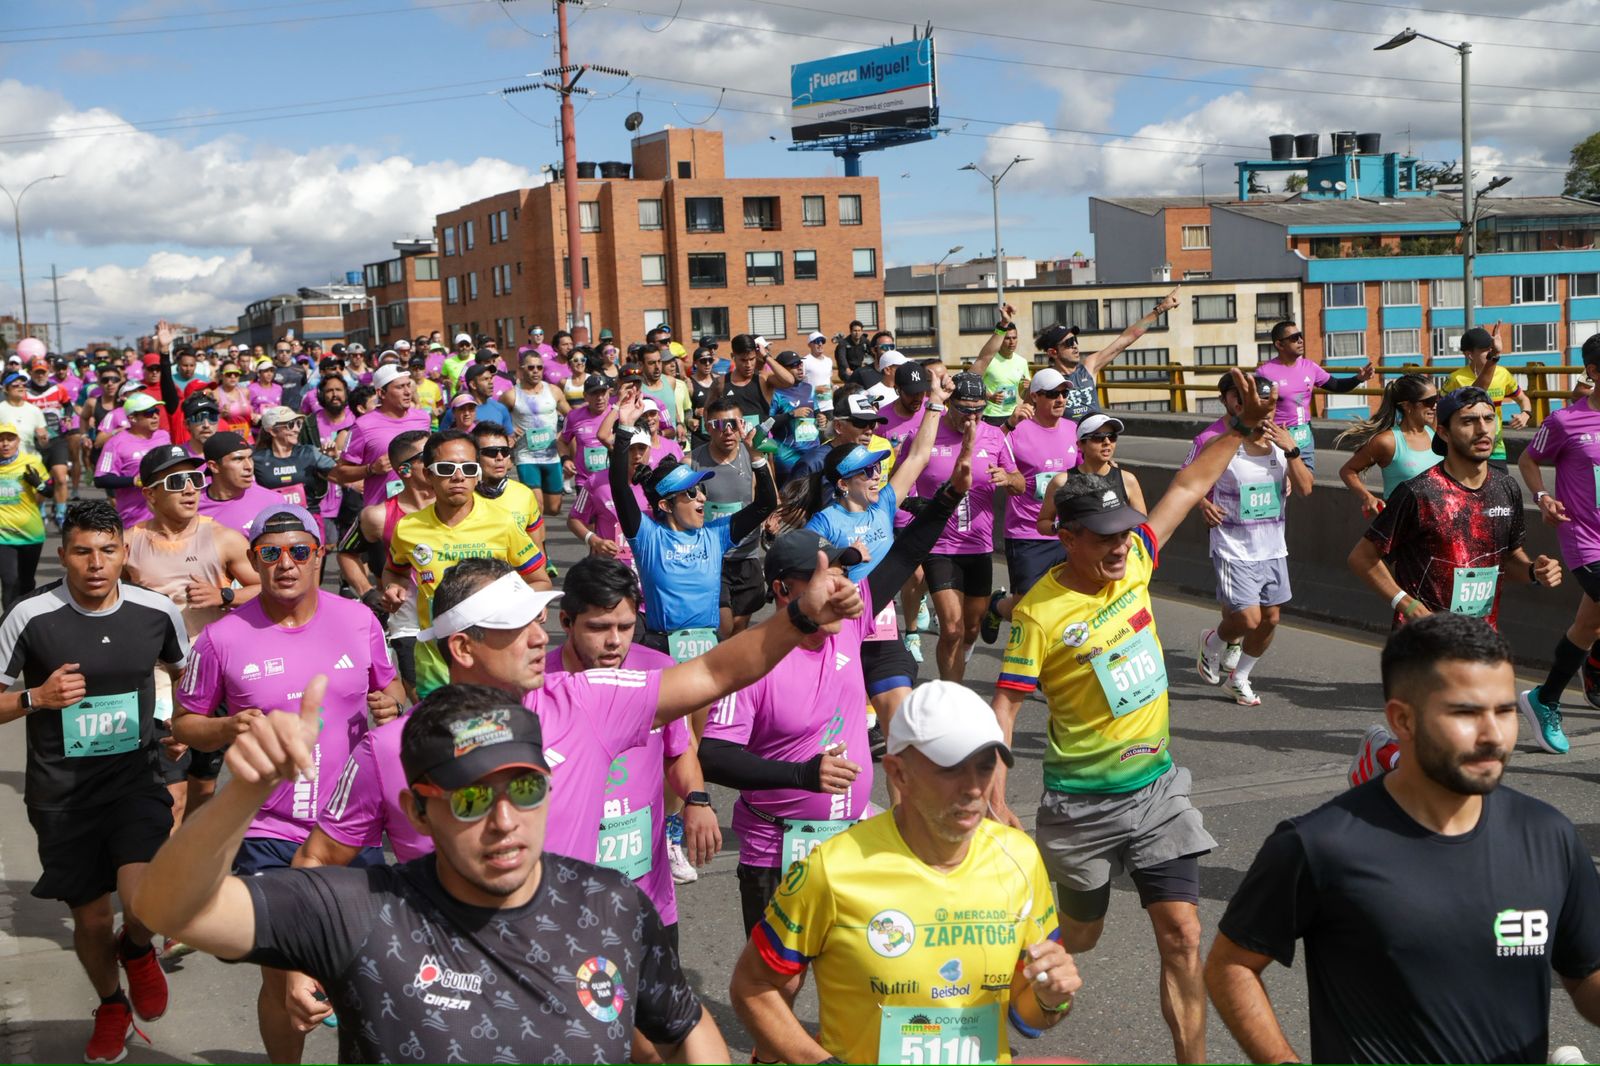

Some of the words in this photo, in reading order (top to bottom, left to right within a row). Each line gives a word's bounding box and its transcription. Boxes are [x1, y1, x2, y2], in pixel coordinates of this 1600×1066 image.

[809, 69, 858, 93] ¡Fuerza
[860, 55, 910, 82] Miguel!
[273, 465, 297, 476] CLAUDIA
[1250, 492, 1271, 508] 814
[1488, 505, 1511, 518] ether
[452, 542, 487, 550] MERCADO
[437, 550, 494, 562] ZAPATOCA
[1460, 580, 1493, 603] 5792
[1092, 589, 1137, 630] ZAPATOCA
[1110, 649, 1157, 692] 5175
[75, 710, 127, 737] 1782
[953, 909, 1007, 920] MERCADO
[924, 924, 1016, 948] ZAPATOCA
[1494, 908, 1549, 947] EB
[1496, 945, 1545, 957] ESPORTES
[931, 983, 970, 1000] Beisbol
[935, 1014, 980, 1025] porvenir
[900, 1035, 981, 1065] 5110
